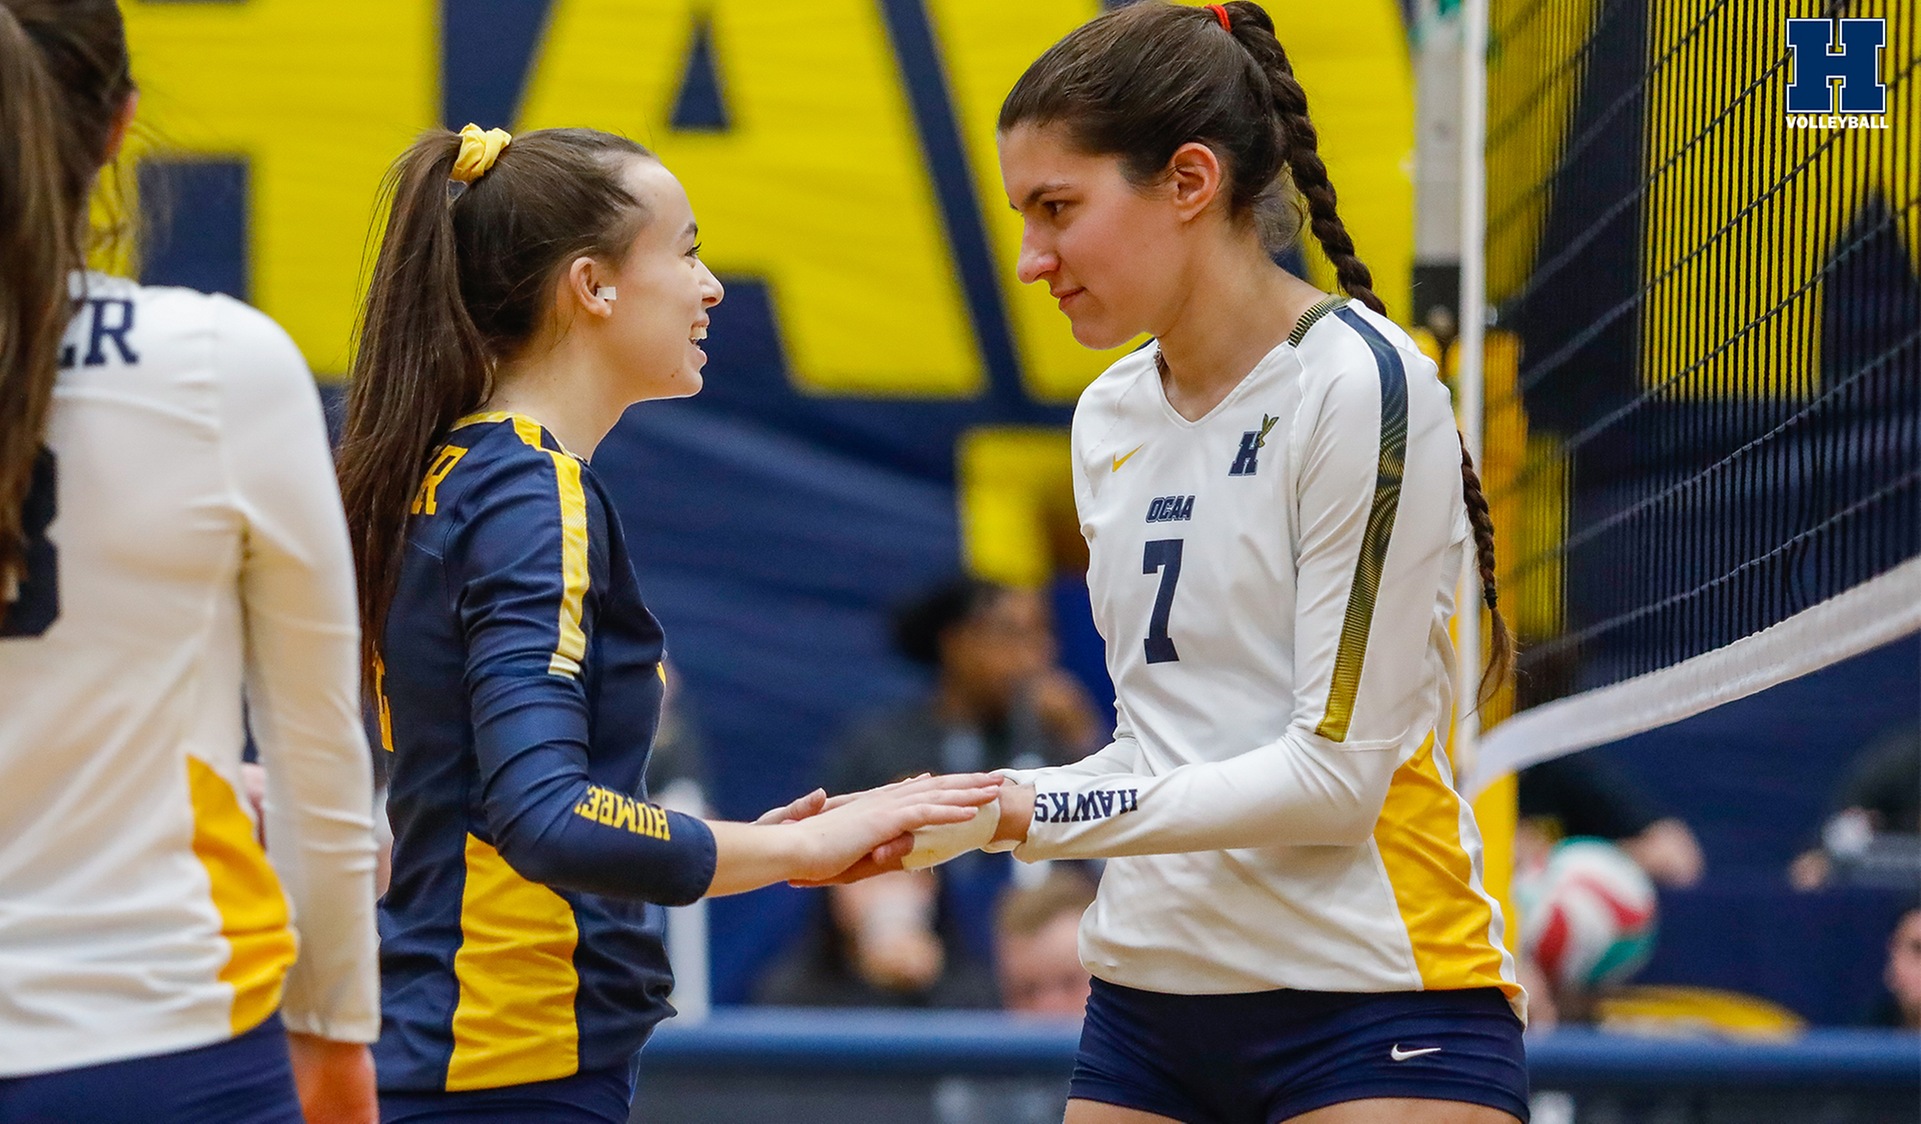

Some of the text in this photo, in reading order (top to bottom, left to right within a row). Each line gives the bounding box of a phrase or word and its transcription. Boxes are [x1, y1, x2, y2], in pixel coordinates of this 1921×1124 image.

[58, 297, 140, 369] R
[1146, 495, 1196, 523] OCAA
[1142, 538, 1185, 664] 7
[1034, 788, 1138, 823] HAWKS
